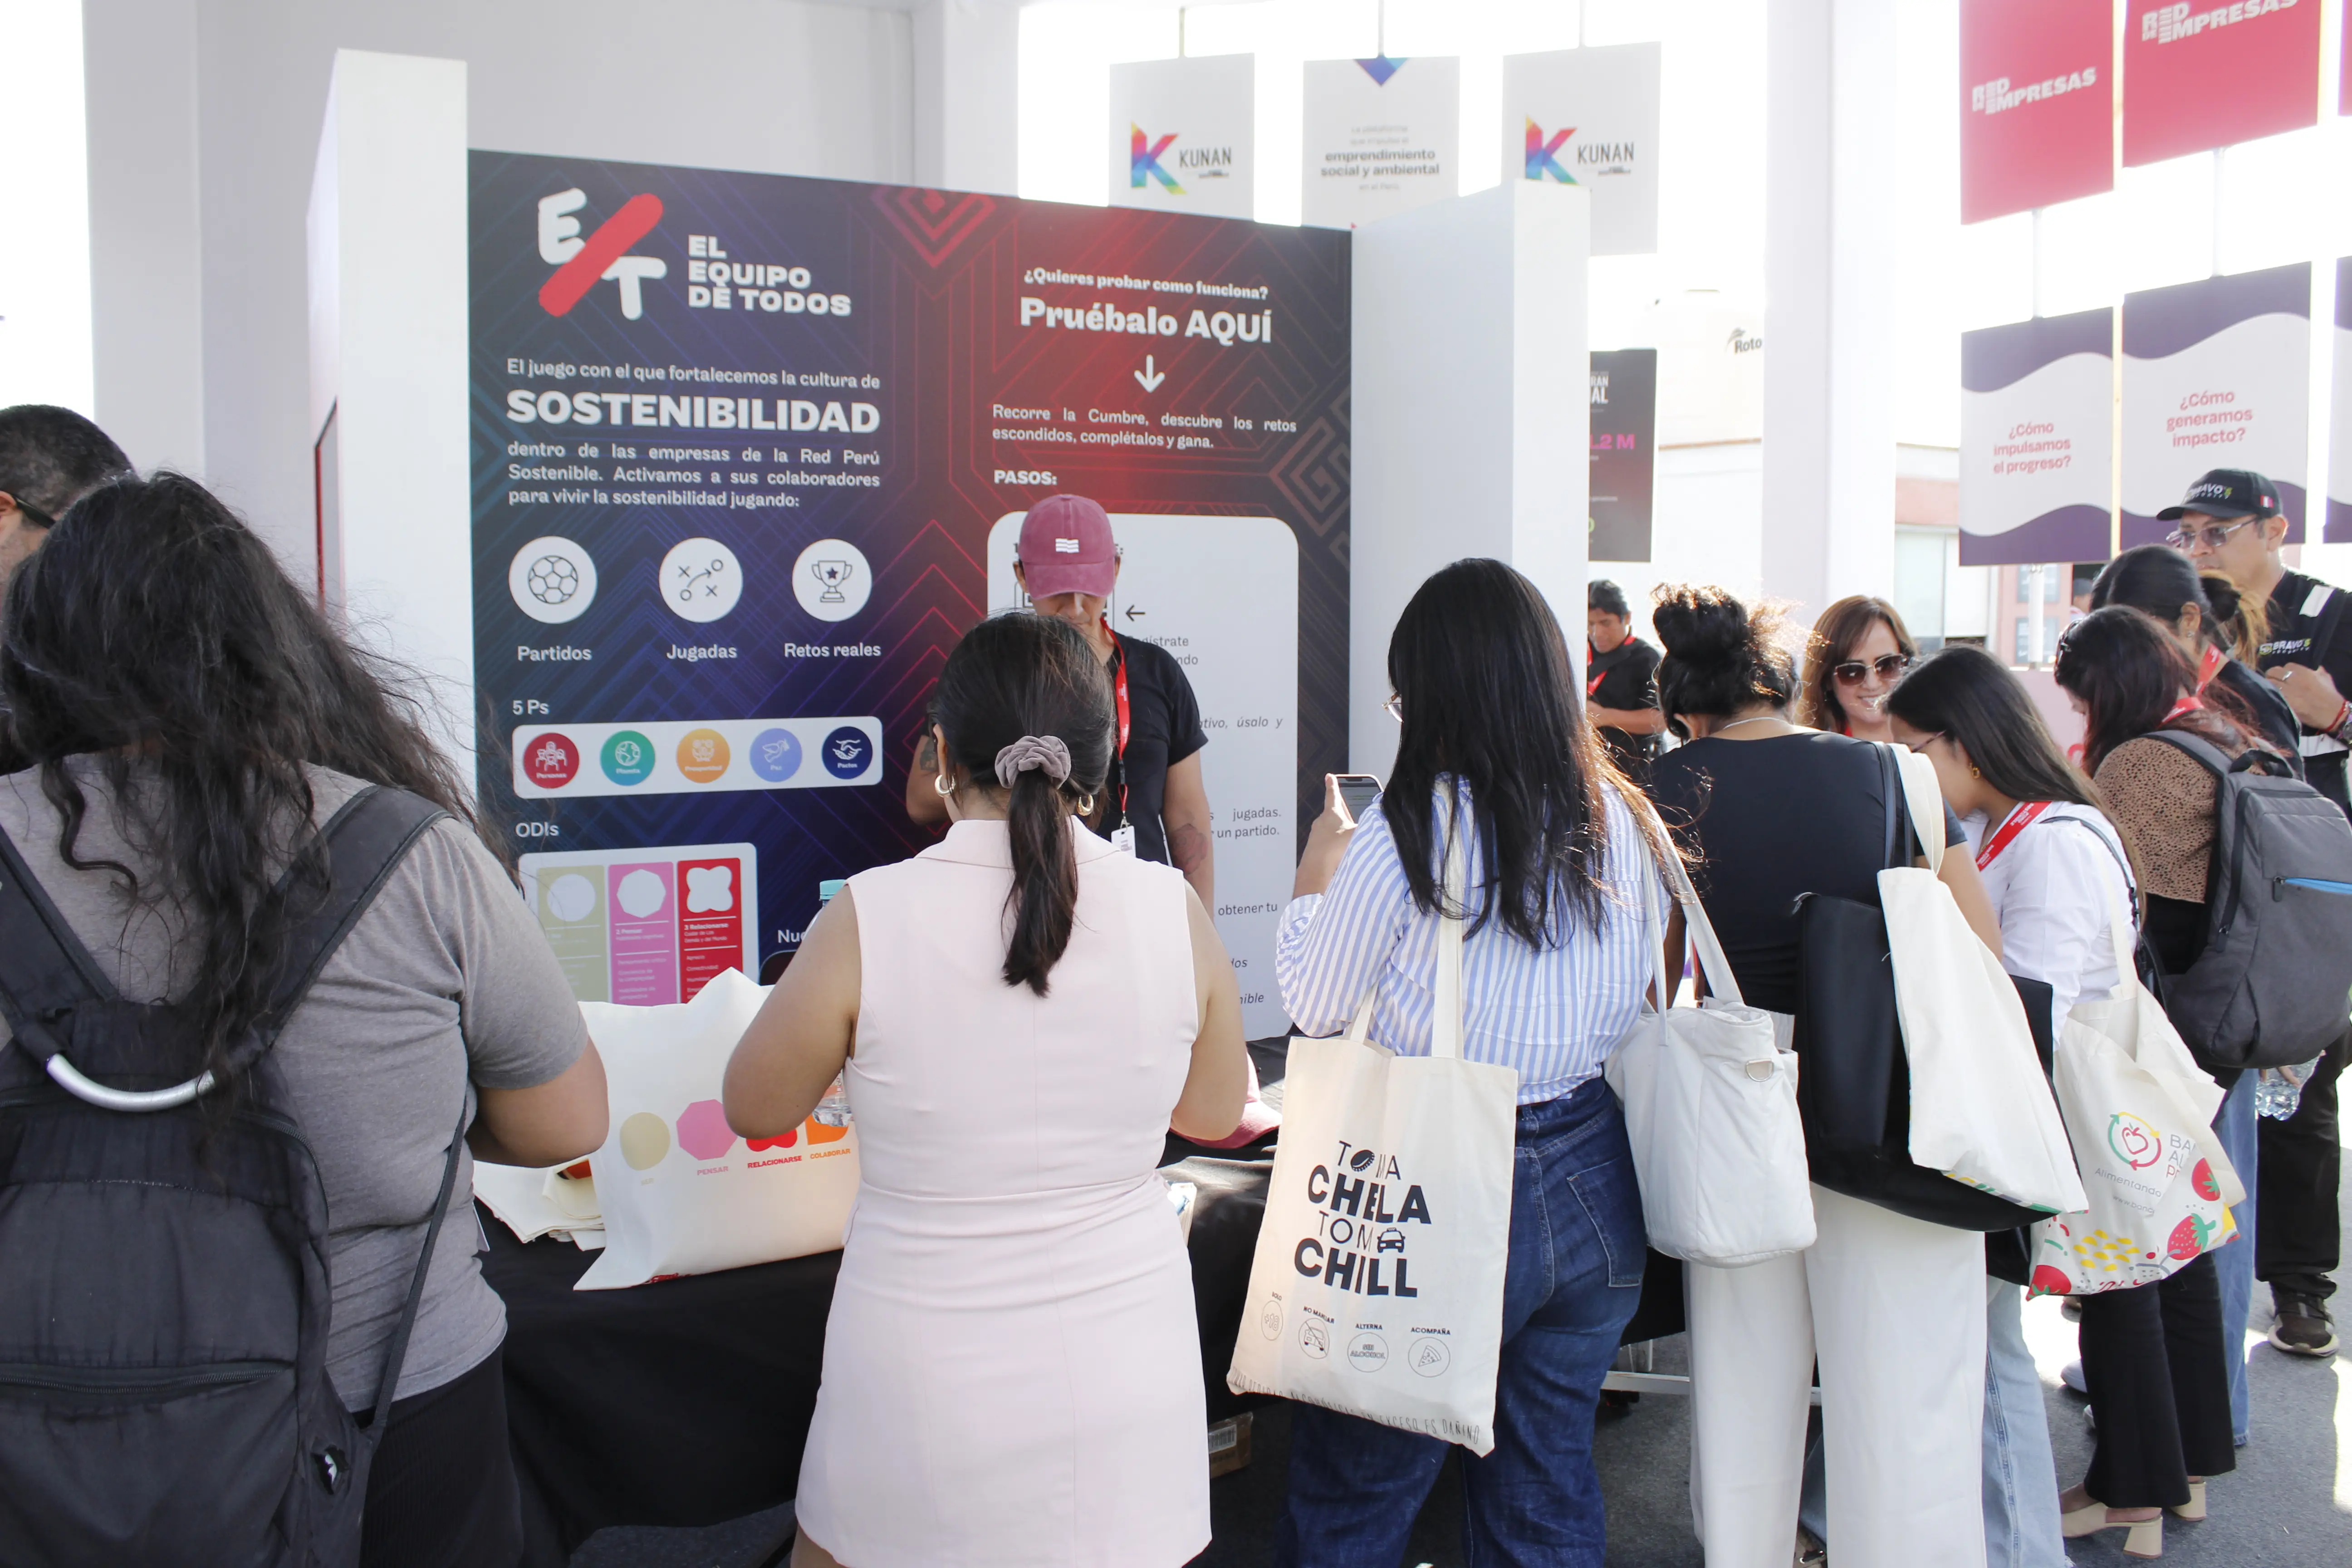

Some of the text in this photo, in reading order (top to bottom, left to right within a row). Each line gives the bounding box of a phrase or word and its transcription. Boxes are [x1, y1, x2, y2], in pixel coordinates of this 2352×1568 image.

[1985, 67, 2097, 115] EMPRESAS
[1180, 147, 1231, 168] KUNAN
[1325, 149, 1435, 162] emprendimiento
[1578, 142, 1634, 164] KUNAN
[1321, 164, 1439, 178] social y ambiental
[688, 235, 725, 258] EL
[688, 260, 811, 288] EQUIPO
[1024, 267, 1268, 300] ¿Quieres probar como funciona?
[688, 286, 851, 316] DE TODOS
[1020, 297, 1271, 347] Pruébalo AQUÍ
[1735, 338, 1762, 354] Roto
[507, 359, 880, 389] El juego con el que fortalecemos la cultura de
[507, 390, 880, 432] SOSTENIBILIDAD
[2180, 391, 2234, 411] ¿Cómo
[993, 404, 1296, 432] Recorre la Cumbre, descubre los retos
[2166, 408, 2253, 432] generamos
[992, 427, 1214, 450] escondidos, complétalos y gana.
[2009, 422, 2054, 439] ¿Cómo
[2173, 428, 2245, 448] impacto?
[1617, 434, 1635, 449] M
[1994, 438, 2070, 456] impulsamos
[508, 442, 879, 465] dentro de las empresas de la Red Perú
[1994, 455, 2071, 475] el progreso?
[509, 465, 880, 486] Sostenible. Activamos a sus colaboradores
[994, 470, 1057, 485] PASOS:
[509, 489, 799, 510] para vivir la sostenibilidad jugando:
[518, 646, 592, 662] Partidos
[666, 644, 737, 662] Jugadas
[784, 642, 881, 657] Retos reales
[513, 701, 549, 715] 5 Ps
[1237, 716, 1269, 727] úsalo
[1276, 718, 1283, 729] y
[1233, 807, 1281, 822] jugadas.
[515, 823, 559, 838] ODIs
[1217, 825, 1279, 839] un partido.
[1218, 902, 1278, 916] obtener tu
[748, 1156, 802, 1169] RELACIONARSE
[810, 1148, 850, 1159] COLABORAR
[697, 1166, 728, 1176] PENSAR
[2095, 1168, 2161, 1197] Alimentando
[1308, 1165, 1431, 1224] CHELA
[1294, 1238, 1417, 1298] CHILL
[1411, 1327, 1450, 1335] ACOMPAÑA
[1350, 1351, 1386, 1359] ALCOHOL
[1442, 1419, 1480, 1444] DAÑINO
